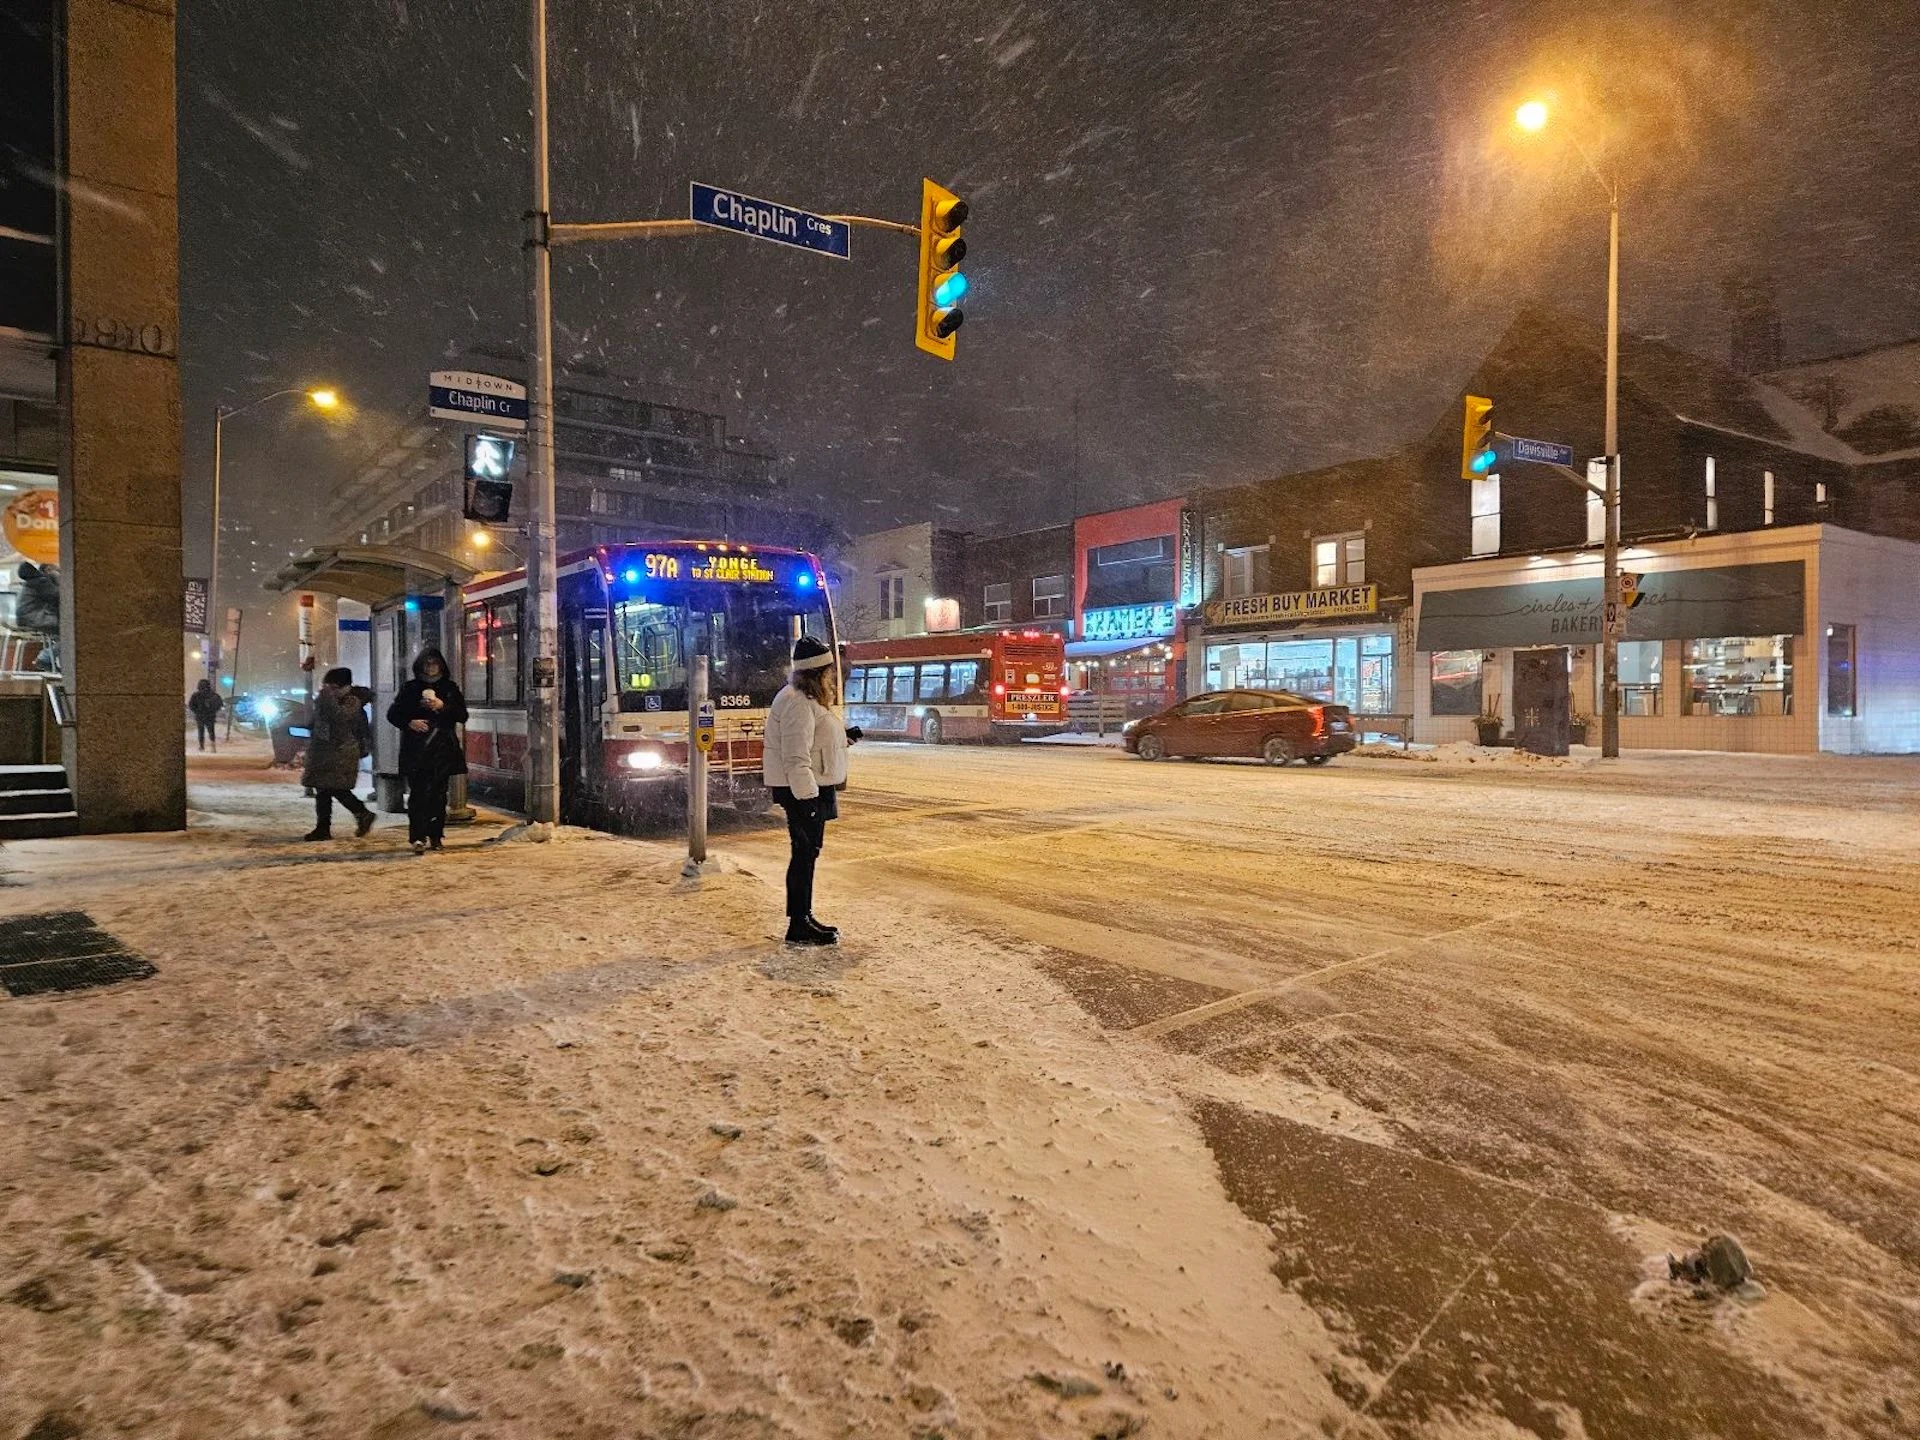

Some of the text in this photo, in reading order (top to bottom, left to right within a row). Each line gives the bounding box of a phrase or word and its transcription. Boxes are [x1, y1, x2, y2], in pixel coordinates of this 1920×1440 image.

[713, 193, 832, 237] Chaplin Cres
[444, 375, 512, 391] MIDTOWN
[449, 390, 511, 412] Chaplin Cr
[1518, 440, 1559, 460] Davisville
[645, 553, 678, 578] 97A
[709, 555, 758, 570] YONGE
[704, 568, 714, 580] ST
[1225, 597, 1268, 616] FRESH
[1272, 594, 1301, 612] BUY
[1306, 587, 1371, 609] MARKET
[1519, 593, 1575, 617] circles
[720, 695, 751, 707] 8366
[1010, 694, 1055, 702] PRESZLER
